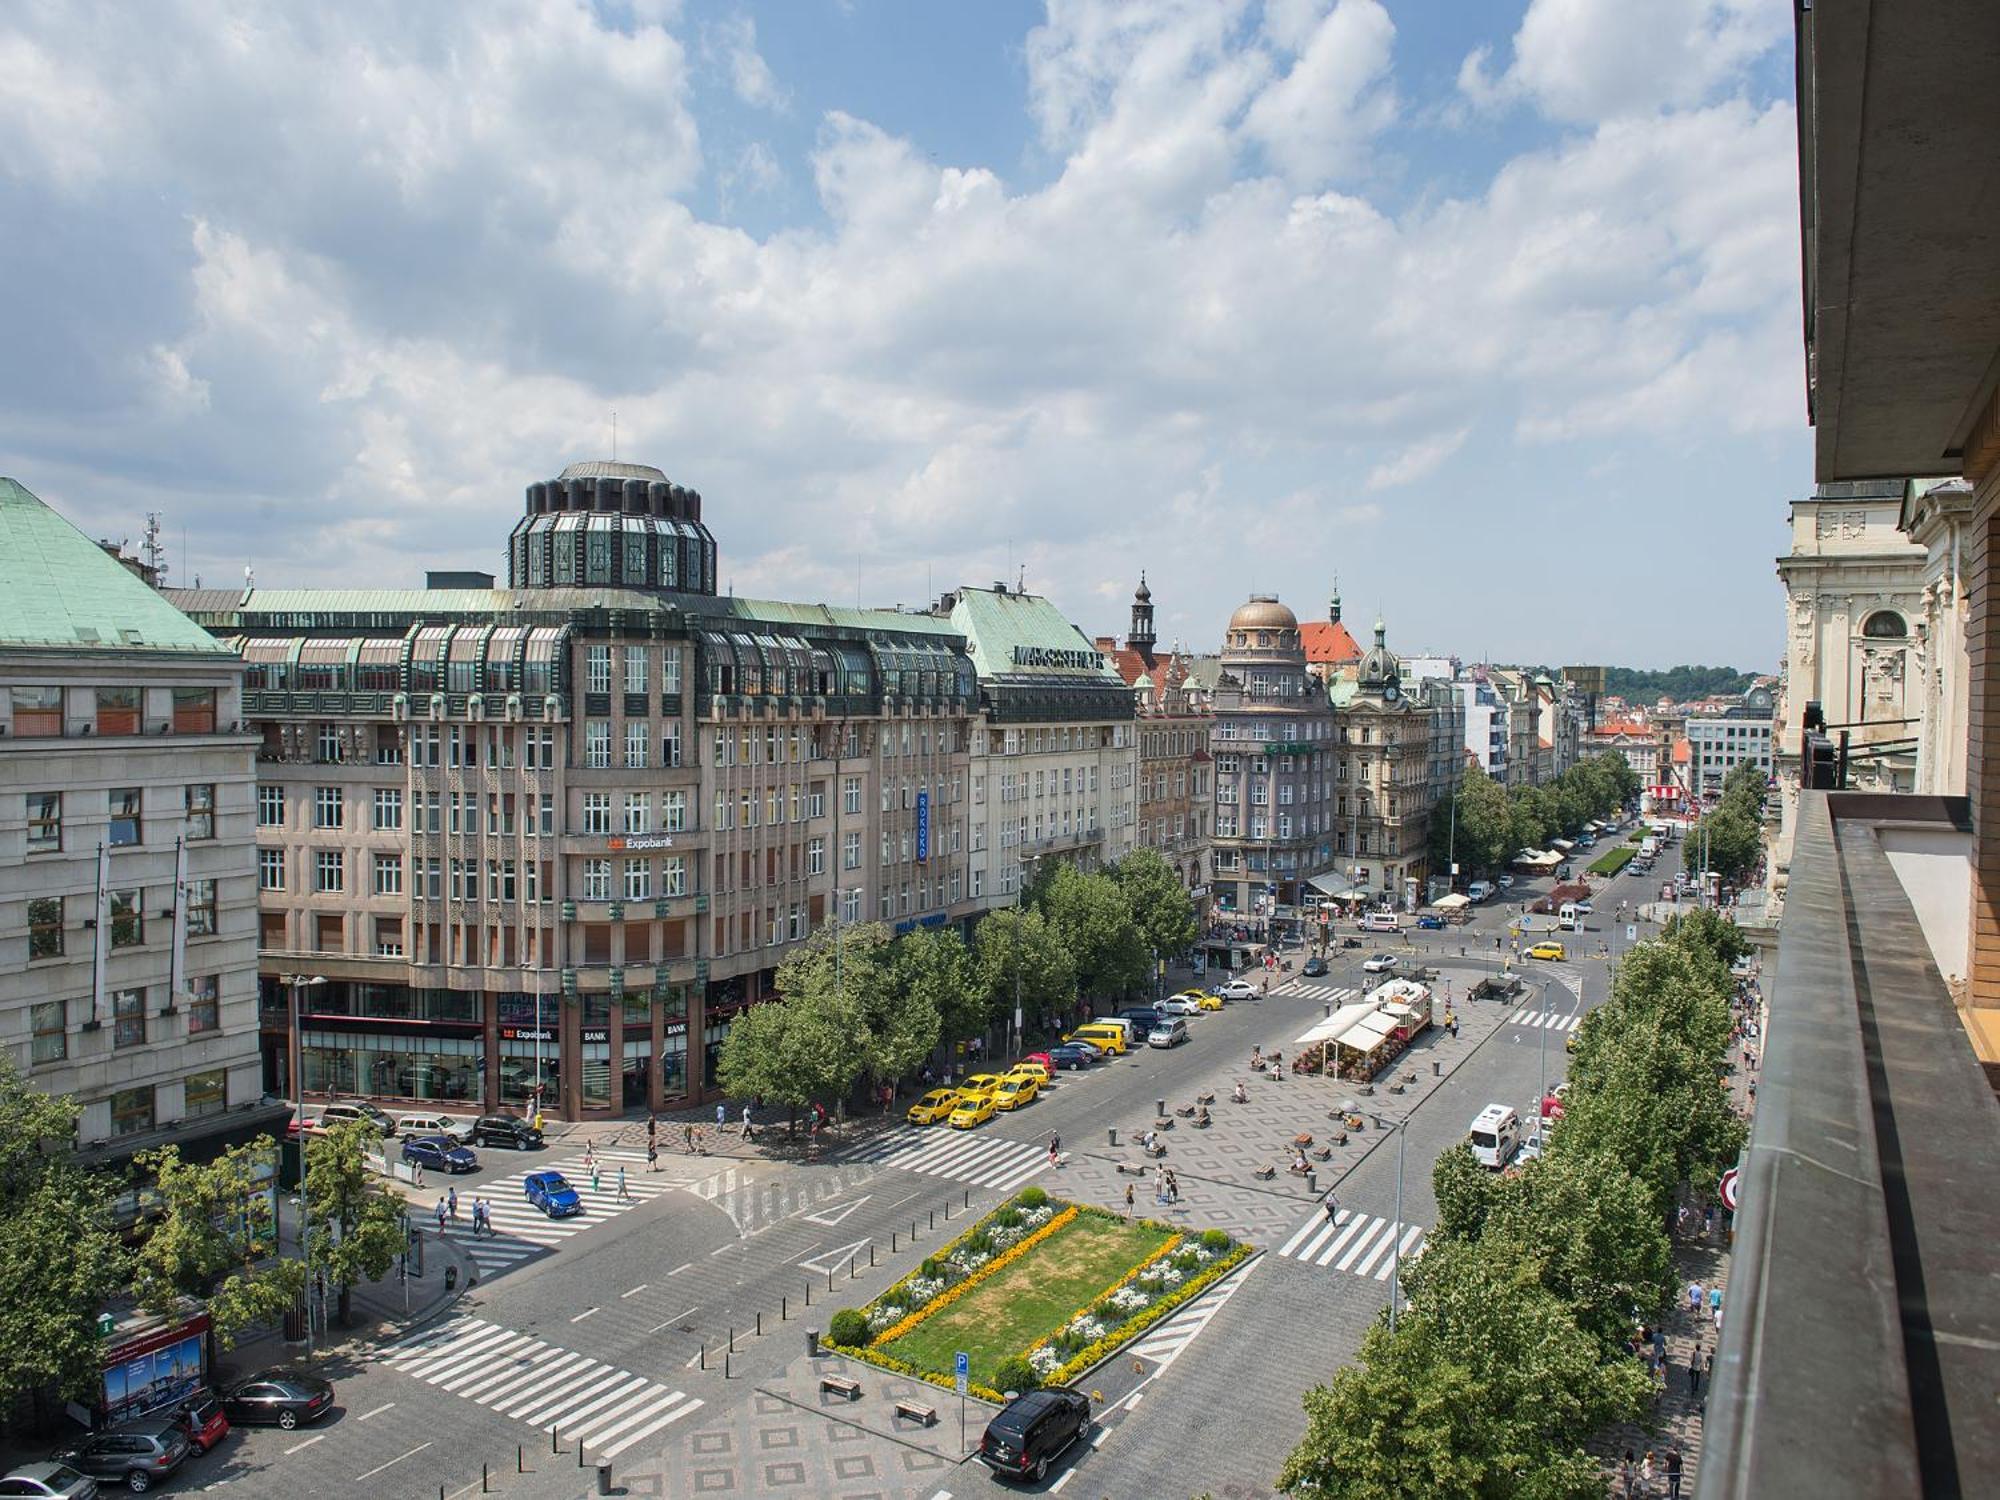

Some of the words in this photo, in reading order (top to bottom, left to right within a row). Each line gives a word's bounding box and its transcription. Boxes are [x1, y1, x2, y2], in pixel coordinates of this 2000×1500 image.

[626, 836, 673, 850] Expobank
[668, 1023, 686, 1034] BANK
[584, 1032, 606, 1041] BANK
[957, 1355, 966, 1367] P
